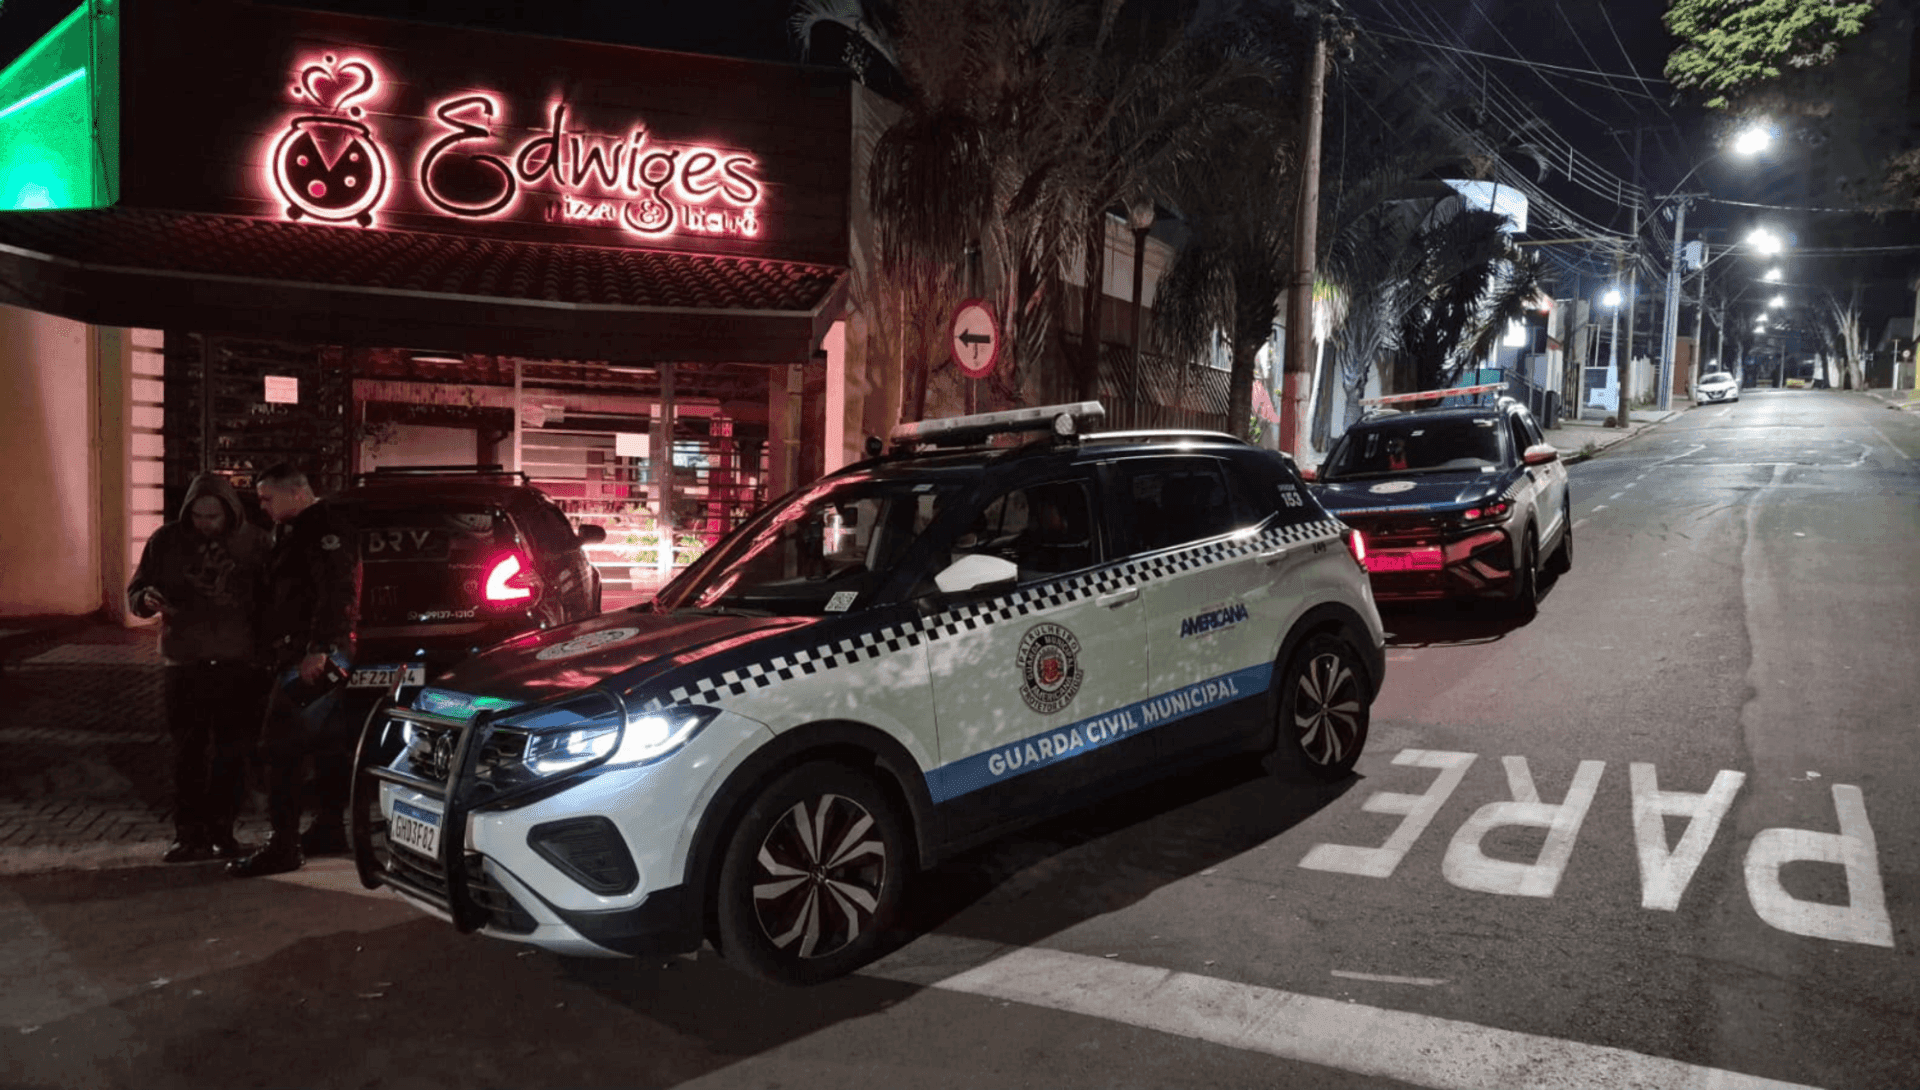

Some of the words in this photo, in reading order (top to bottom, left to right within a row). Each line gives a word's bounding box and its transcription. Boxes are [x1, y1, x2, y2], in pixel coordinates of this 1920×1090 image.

[420, 96, 758, 232] Edwiges
[1019, 625, 1078, 664] PATRULHEIRO
[1180, 603, 1249, 638] AMERICANA
[988, 729, 1083, 776] GUARDA
[1086, 711, 1138, 744] CIVIL
[1143, 676, 1239, 725] MUNICIPAL
[1297, 748, 1895, 948] PARE
